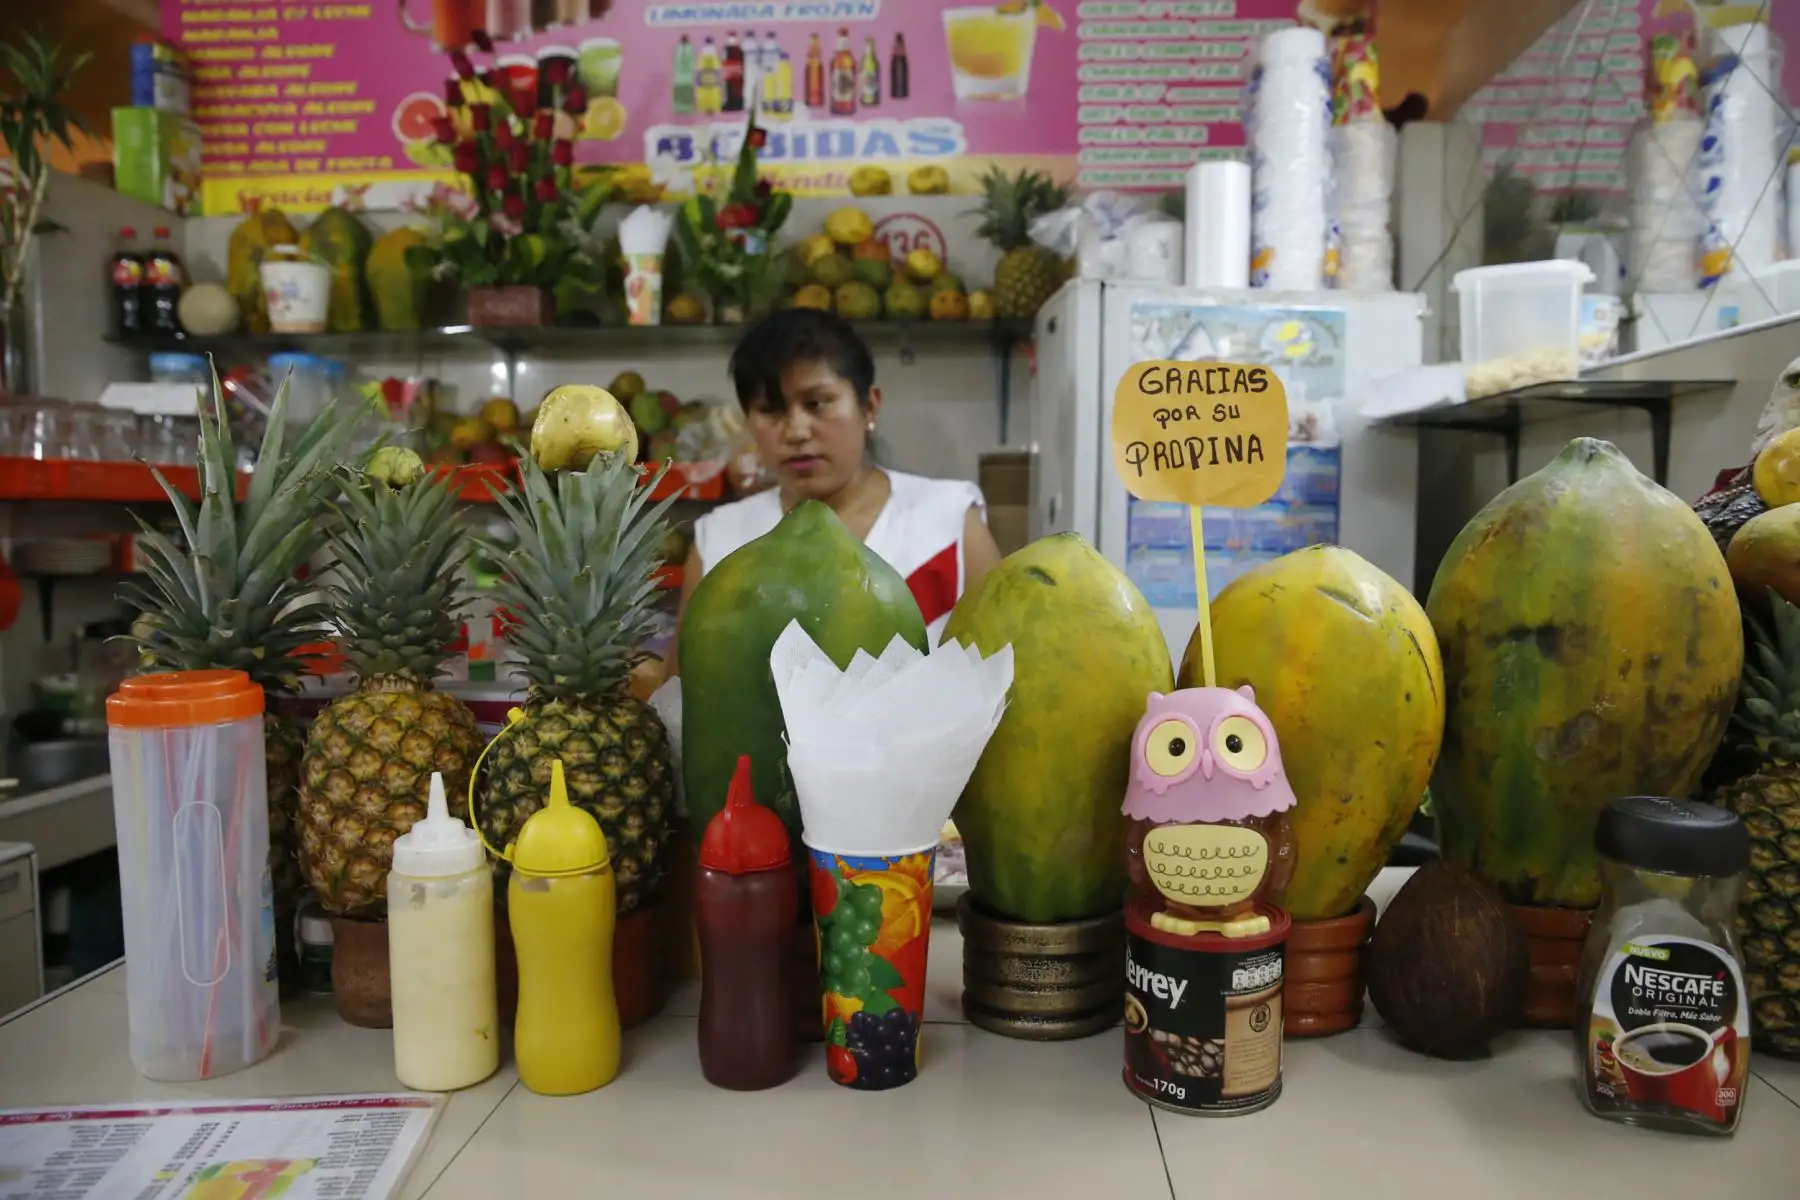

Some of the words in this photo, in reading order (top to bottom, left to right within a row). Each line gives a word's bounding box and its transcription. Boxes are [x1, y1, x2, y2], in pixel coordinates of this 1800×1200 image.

[312, 5, 372, 18] LECHE
[650, 5, 773, 21] LIMONADA
[784, 2, 875, 17] FROZEN
[187, 46, 255, 60] ANGO
[253, 121, 295, 135] CON
[299, 119, 359, 134] LECHE
[295, 157, 322, 171] DE
[326, 155, 394, 170] FRUTA
[1138, 366, 1269, 395] GRACIAS
[1212, 403, 1241, 422] SU
[1125, 433, 1265, 478] PROPINA
[1629, 946, 1666, 959] NUEVO
[1624, 963, 1726, 997] NESCAFÉ
[1632, 986, 1719, 1008] ORIGINAL
[1153, 1078, 1186, 1100] 170g
